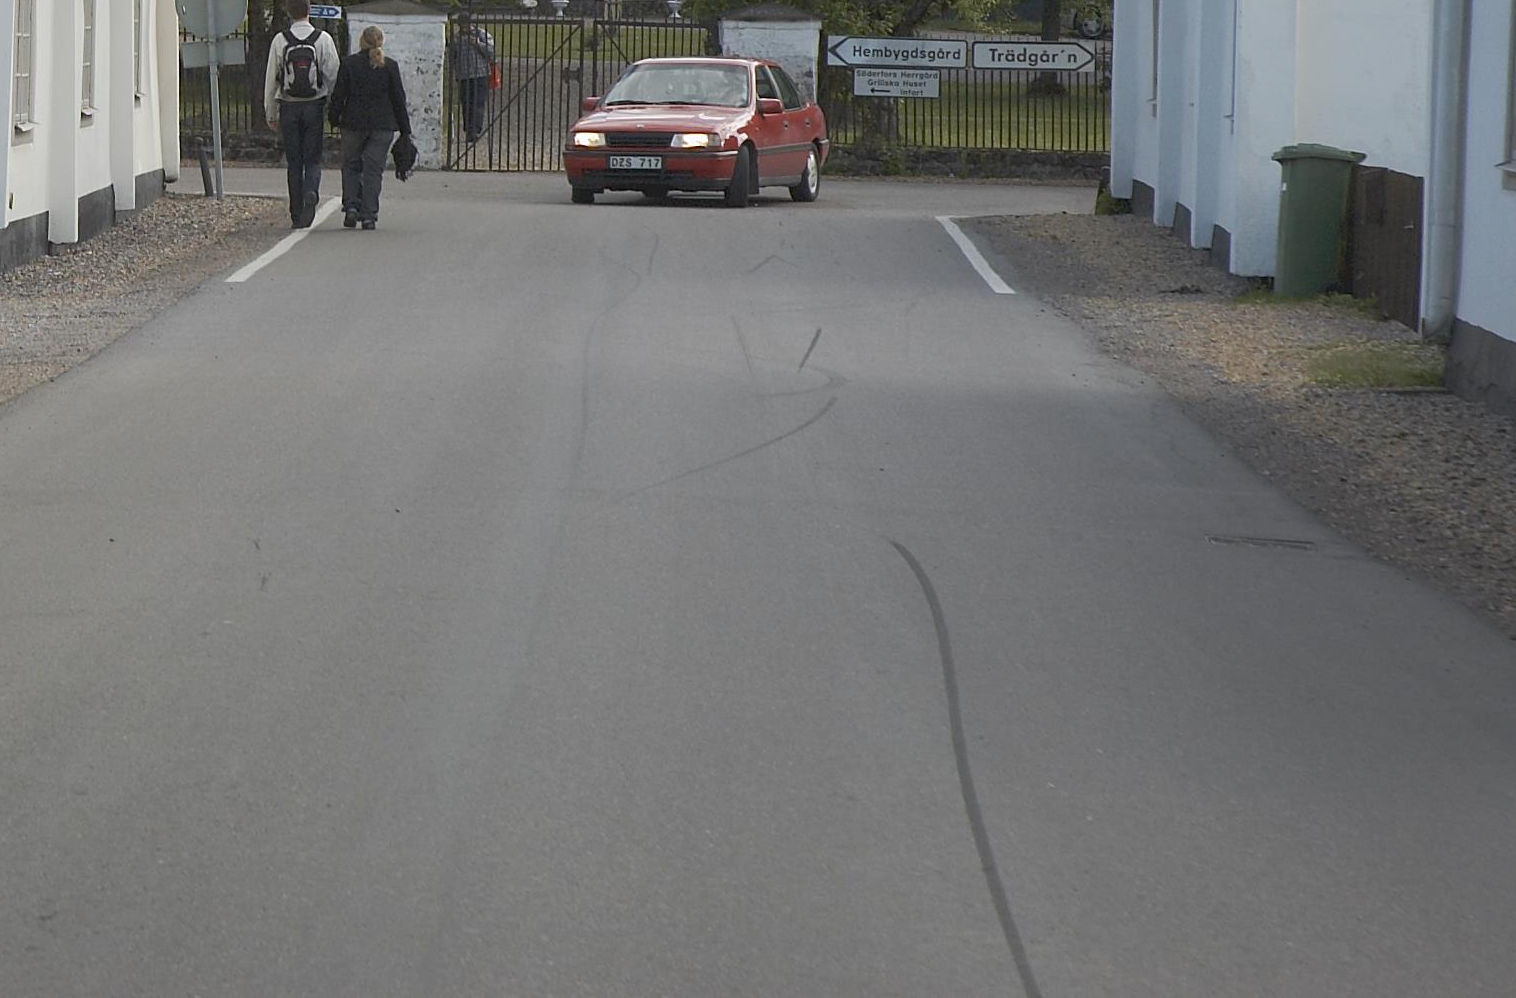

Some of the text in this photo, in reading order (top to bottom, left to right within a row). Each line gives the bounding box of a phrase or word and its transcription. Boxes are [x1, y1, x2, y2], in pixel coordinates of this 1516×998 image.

[852, 45, 962, 62] Hembygdsgård
[611, 157, 660, 168] DZS 717
